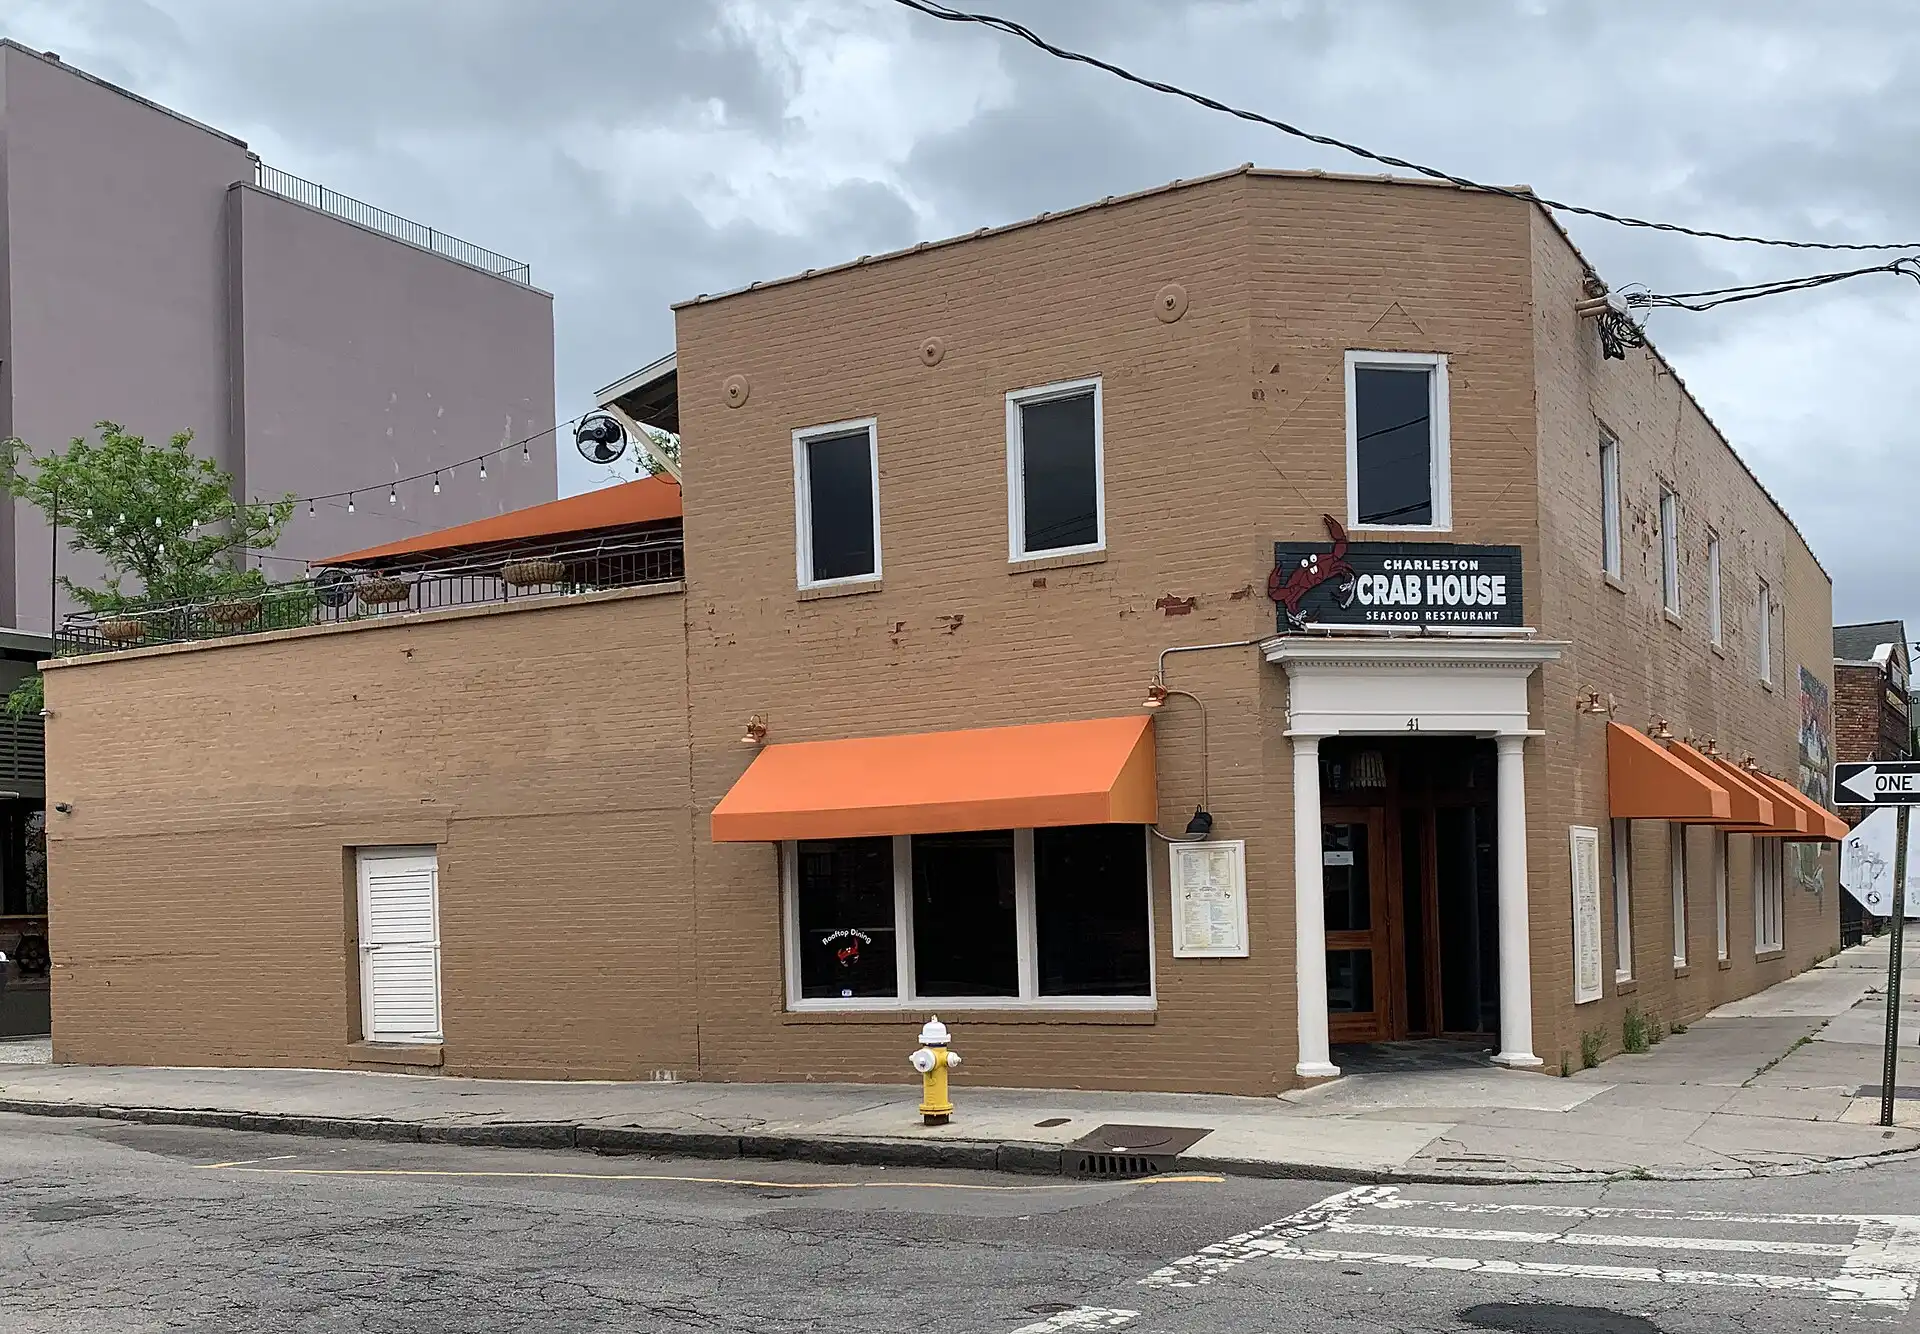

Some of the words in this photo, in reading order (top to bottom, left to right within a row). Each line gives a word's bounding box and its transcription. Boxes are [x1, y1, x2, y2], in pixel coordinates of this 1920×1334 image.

[1384, 560, 1479, 570] CHARLESTON
[1357, 574, 1422, 605] CRAB
[1427, 575, 1506, 605] HOUSE
[1366, 611, 1419, 621] SEAFOOD
[1425, 611, 1499, 621] RESTAURANT
[1406, 717, 1419, 732] 41
[1875, 775, 1913, 791] ONE
[822, 930, 849, 945] Rooftop
[850, 928, 872, 945] Dining
